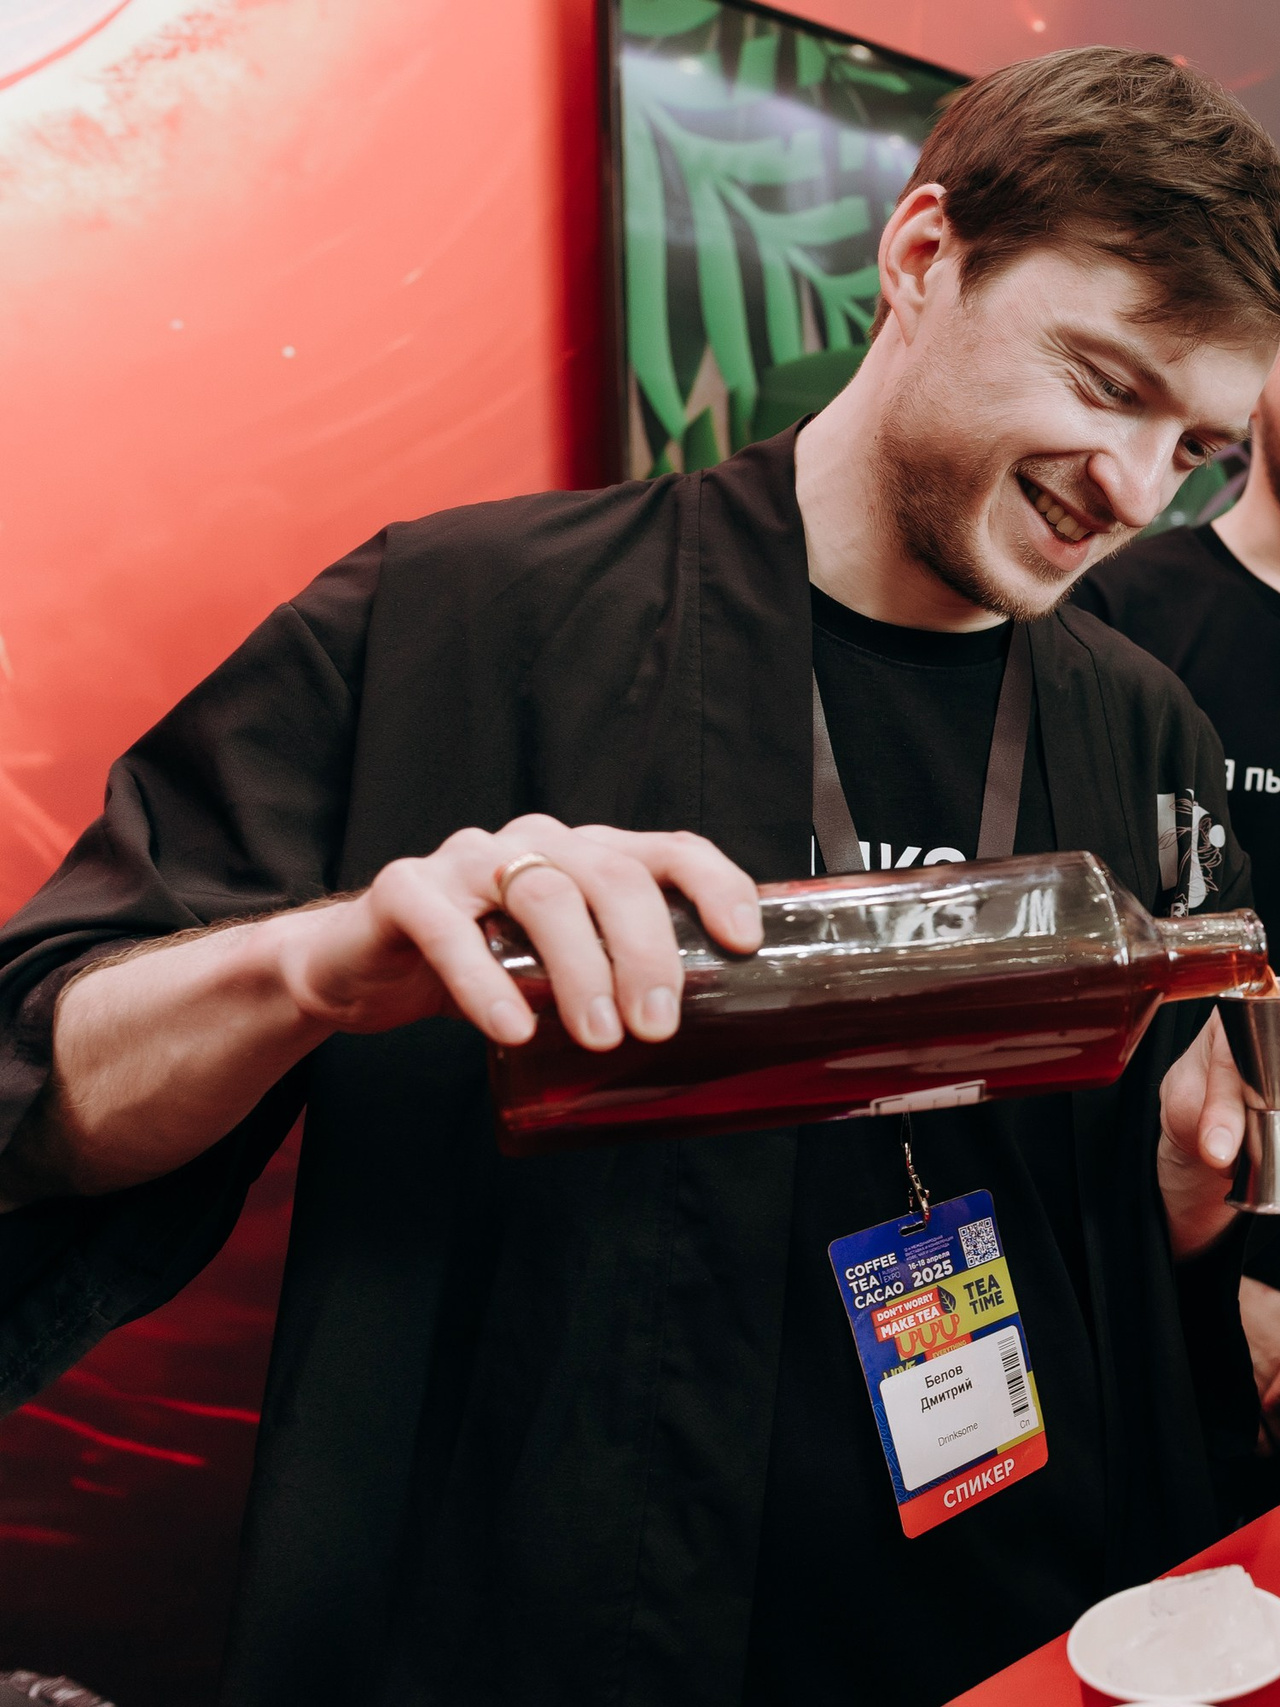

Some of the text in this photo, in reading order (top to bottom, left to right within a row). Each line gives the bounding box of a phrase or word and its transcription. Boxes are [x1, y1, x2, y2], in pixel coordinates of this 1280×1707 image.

[845, 1253, 897, 1280] COFFEE
[908, 1251, 950, 1271] 16-18 апреля
[912, 1260, 953, 1287] 2025
[849, 1275, 880, 1294] TEA
[854, 1281, 904, 1309] CACAO
[963, 1274, 1000, 1300] TEA
[877, 1292, 933, 1321] DON'T WORRY
[969, 1290, 1004, 1315] TIME
[880, 1306, 940, 1338] MAKE TEA
[925, 1365, 963, 1388] Белов
[920, 1378, 973, 1412] Дмитрий
[938, 1421, 979, 1447] Drinksome
[943, 1458, 1015, 1508] СПИКЕР
